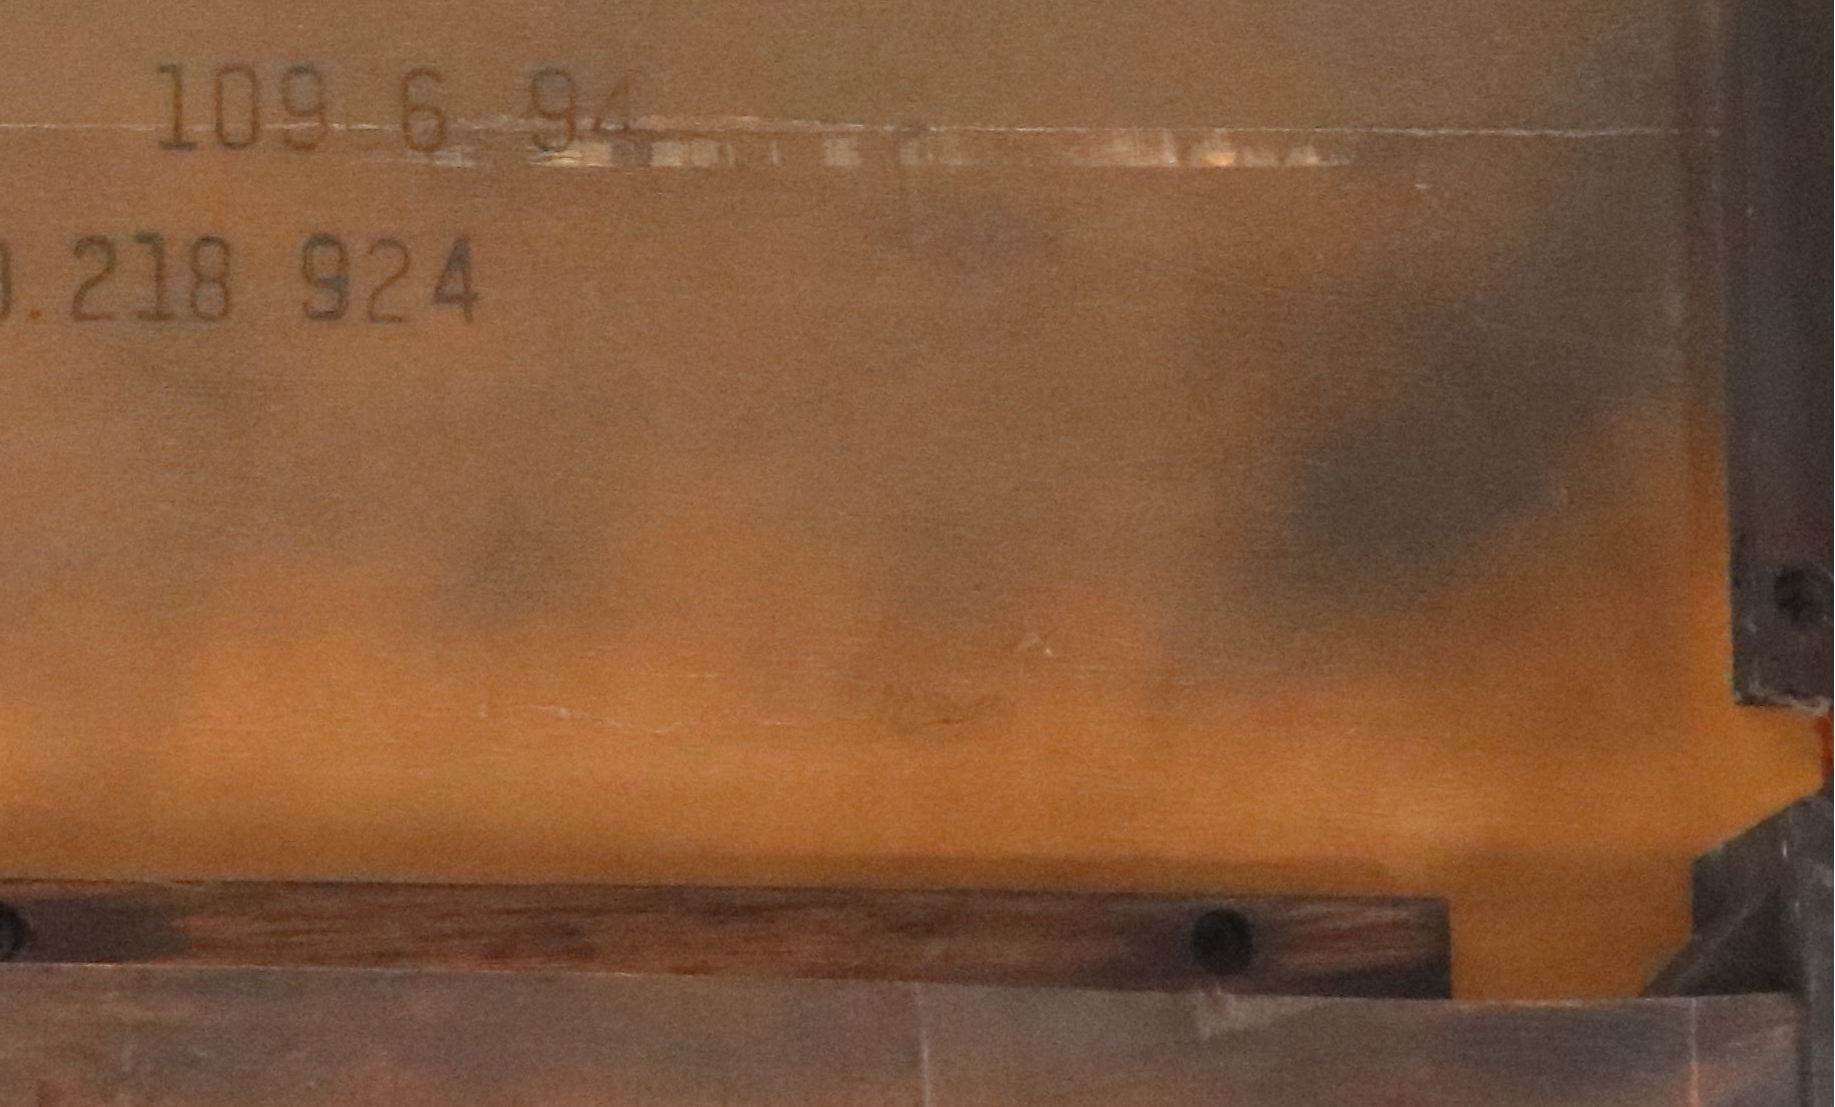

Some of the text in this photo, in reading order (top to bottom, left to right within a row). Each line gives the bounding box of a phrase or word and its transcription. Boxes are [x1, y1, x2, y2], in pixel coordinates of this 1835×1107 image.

[157, 62, 329, 152] 109
[402, 66, 448, 154] 6
[530, 65, 632, 153] 94
[300, 230, 481, 324] 924
